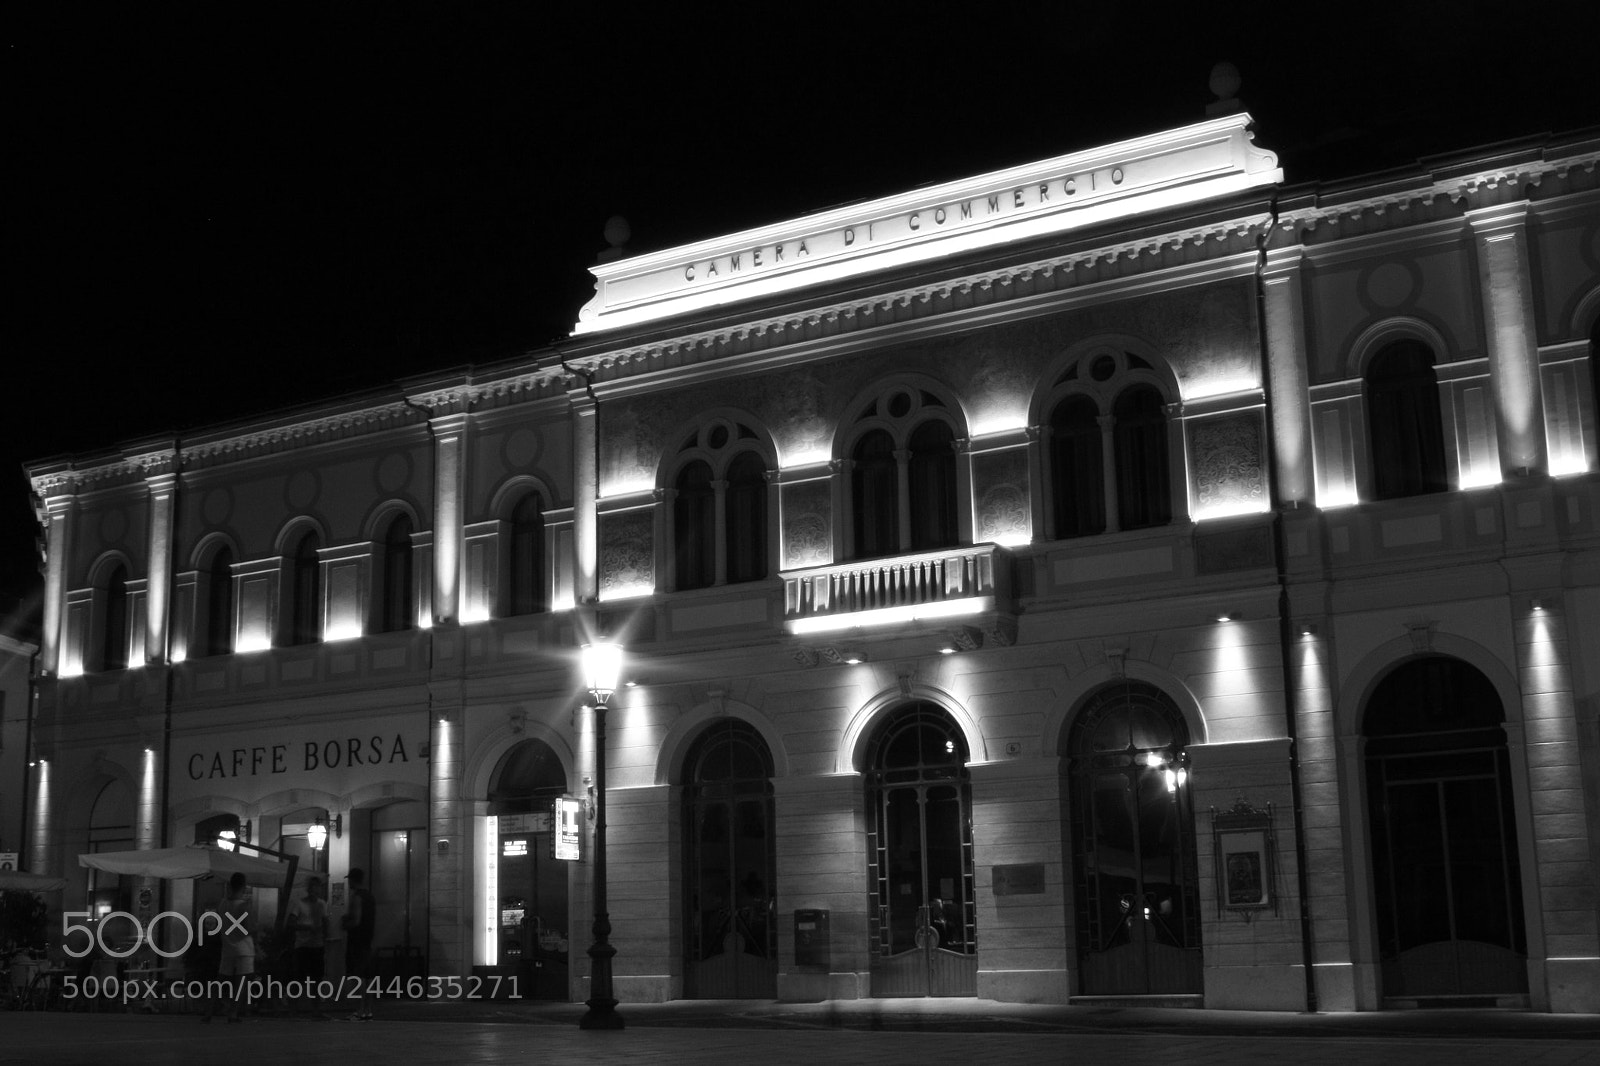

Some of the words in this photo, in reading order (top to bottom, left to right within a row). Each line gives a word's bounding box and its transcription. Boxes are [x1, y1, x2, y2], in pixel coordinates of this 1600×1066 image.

[685, 241, 810, 280] CAMERA
[844, 223, 875, 246] DI
[910, 169, 1124, 230] COMMERCIO
[305, 734, 409, 771] BORSA
